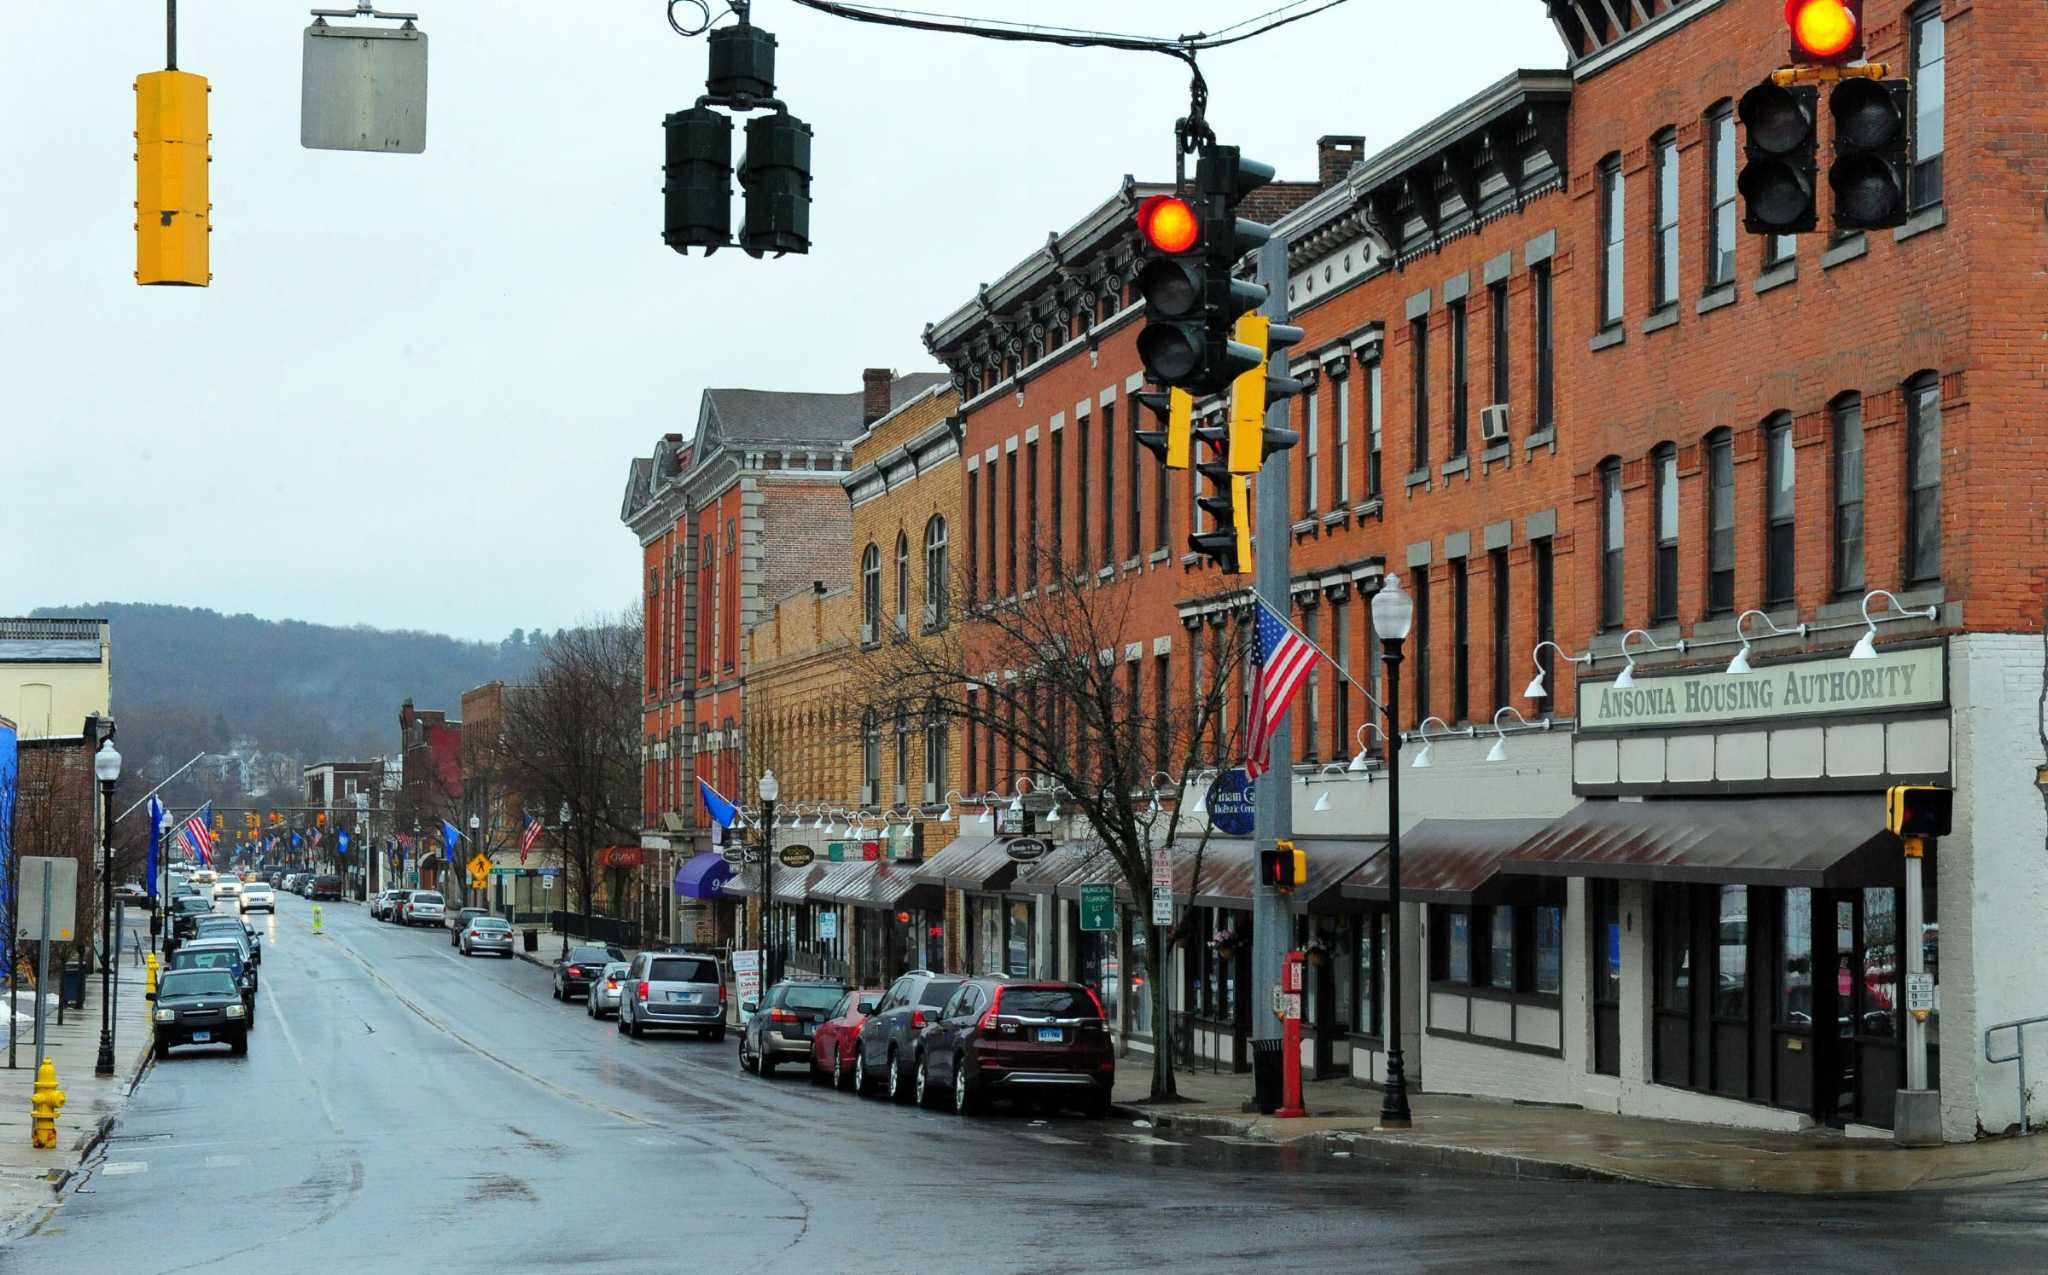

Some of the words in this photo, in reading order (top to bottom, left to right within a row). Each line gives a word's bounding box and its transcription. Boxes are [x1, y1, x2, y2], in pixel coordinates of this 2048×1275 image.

[1598, 687, 1676, 718] ANSONIA
[1684, 679, 1774, 714] HOUSING
[1783, 663, 1916, 706] AUTHORITY
